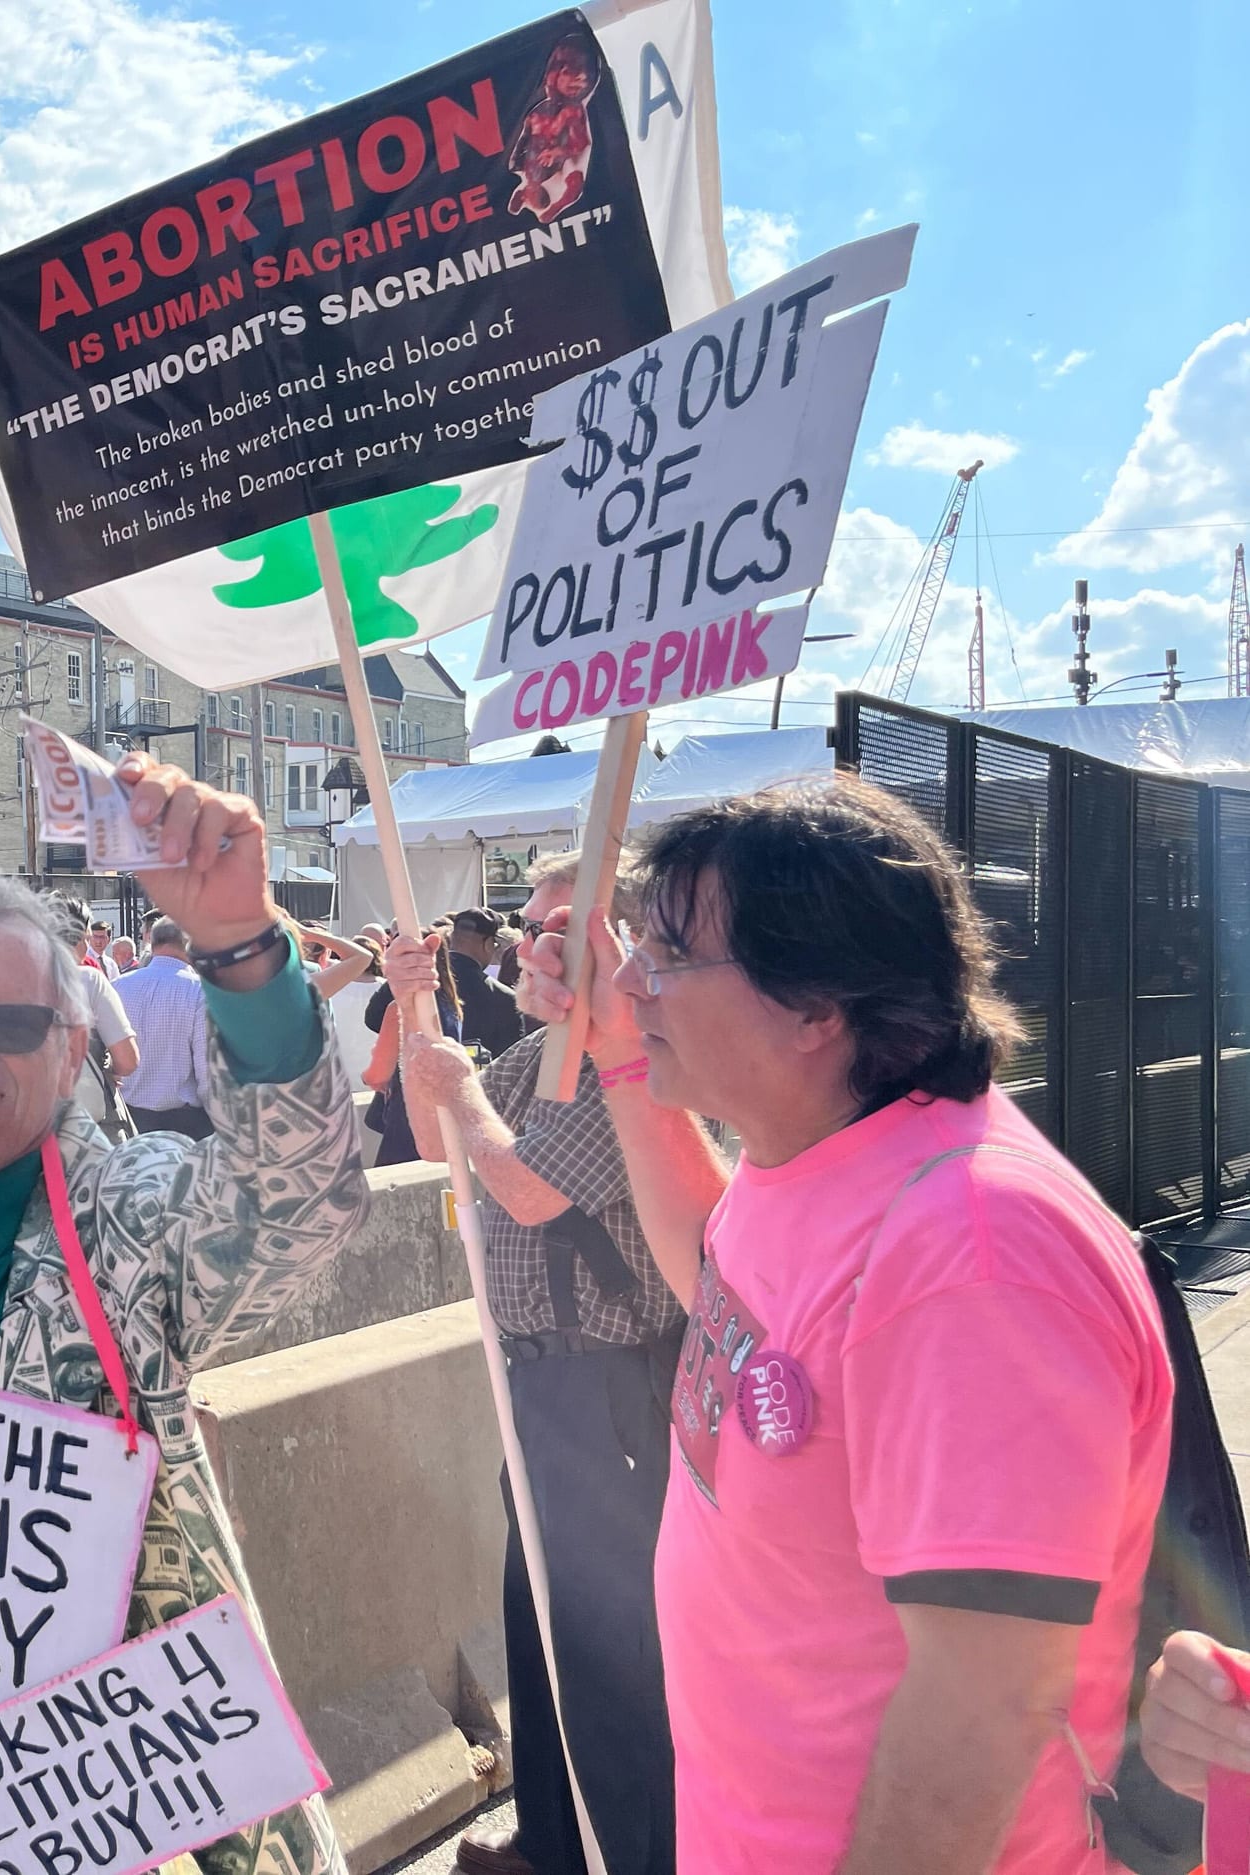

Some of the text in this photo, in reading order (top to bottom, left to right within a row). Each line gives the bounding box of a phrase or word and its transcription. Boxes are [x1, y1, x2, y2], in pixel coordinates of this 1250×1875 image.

[38, 77, 505, 332] ABORTION
[68, 184, 493, 369] IS HUMAN SACRIFICE
[6, 394, 85, 440] “THE
[89, 305, 307, 413] DEMOCRAT’S
[319, 205, 612, 326] SACRAMENT”
[95, 308, 515, 469] The broken bodies and shed blood of
[561, 274, 835, 500] $$ OUT
[55, 337, 602, 525] the innocent, is the wretched un-holy communion
[101, 398, 535, 548] that binds the Democrat party togethe
[596, 443, 702, 548] OF
[500, 477, 809, 664] POLITICS
[512, 607, 775, 730] CODEPINK
[750, 1366, 778, 1445] PINK
[765, 1360, 798, 1445] CODE
[161, 1631, 226, 1690] 4
[30, 1769, 225, 1875] BUY!!!
